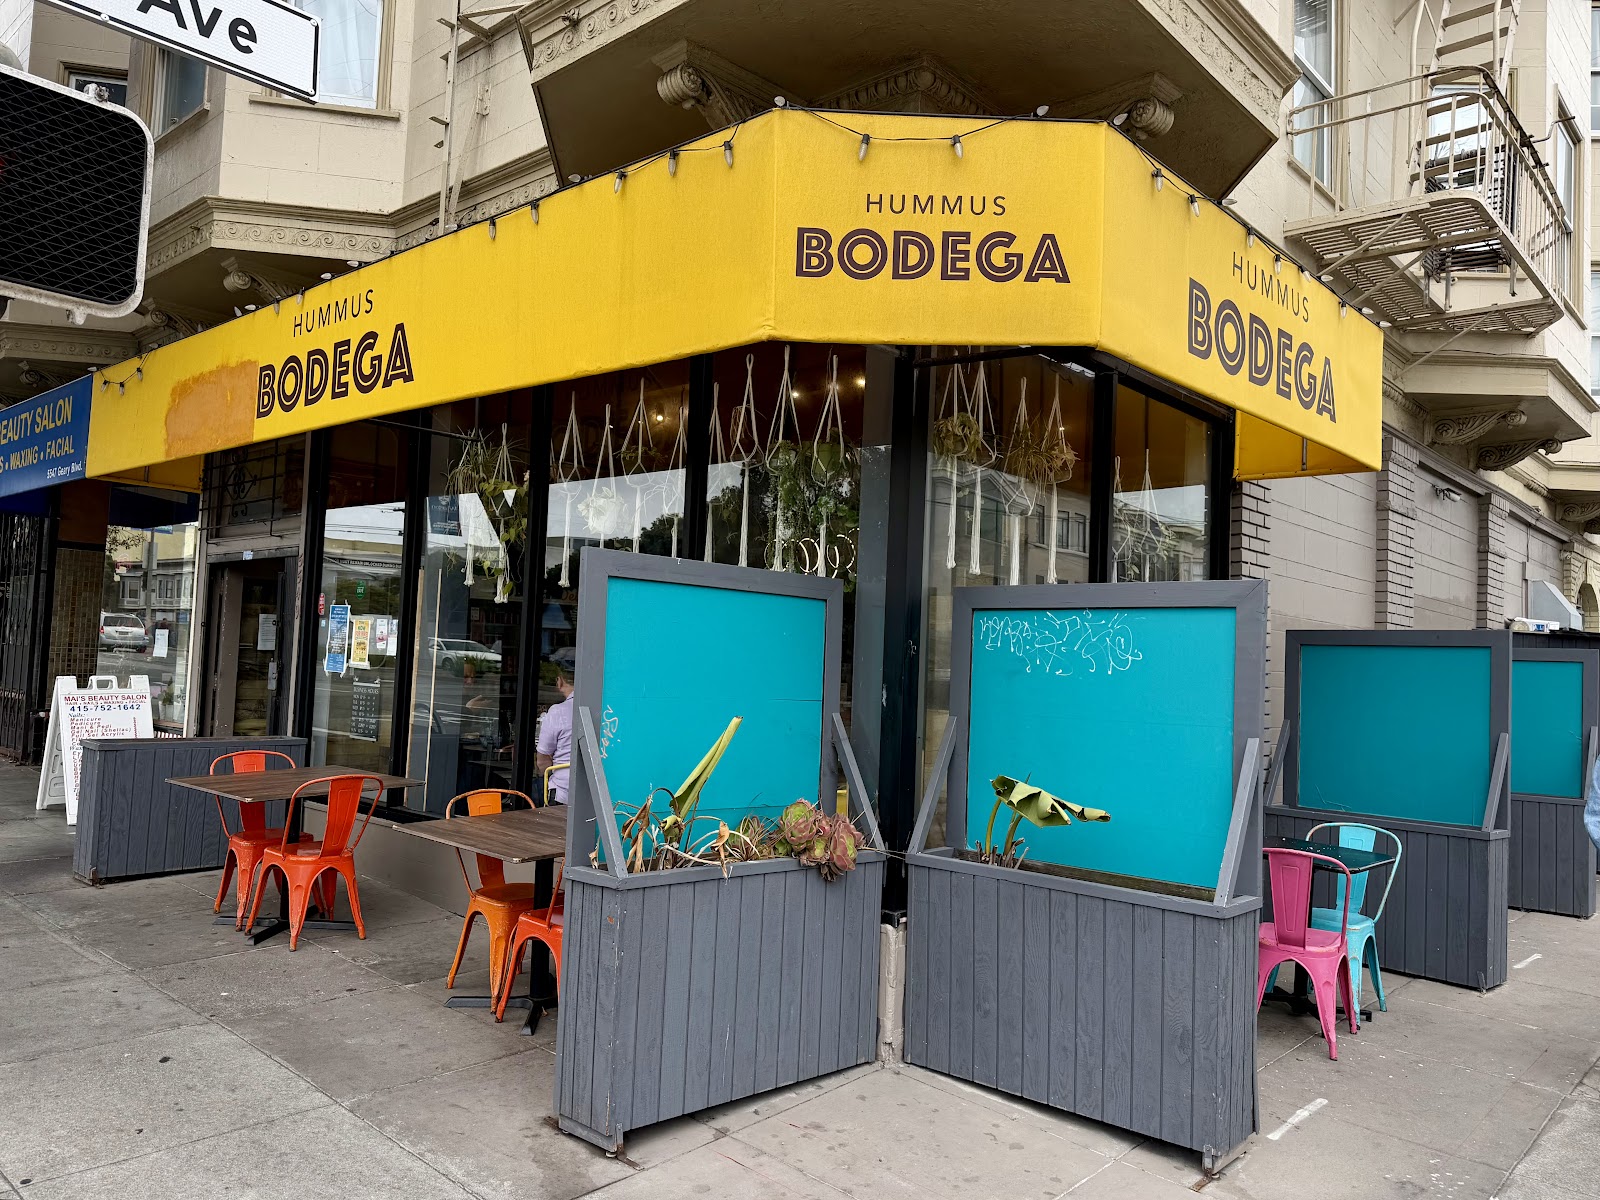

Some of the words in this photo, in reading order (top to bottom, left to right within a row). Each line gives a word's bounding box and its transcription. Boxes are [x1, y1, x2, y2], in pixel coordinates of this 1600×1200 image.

[866, 193, 1007, 216] HUMMUS
[795, 226, 1071, 284] BODEGA
[1232, 251, 1309, 323] HUMMUS
[293, 289, 374, 337] HUMMUS
[256, 322, 415, 419] BODEGA
[1188, 276, 1337, 424] BODEGA
[0, 410, 34, 445] EAUTY
[34, 395, 73, 434] SALON
[10, 445, 39, 471] WAXING
[45, 434, 75, 460] FACIAL
[57, 465, 71, 477] Geary
[70, 704, 141, 712] 415-752-1642
